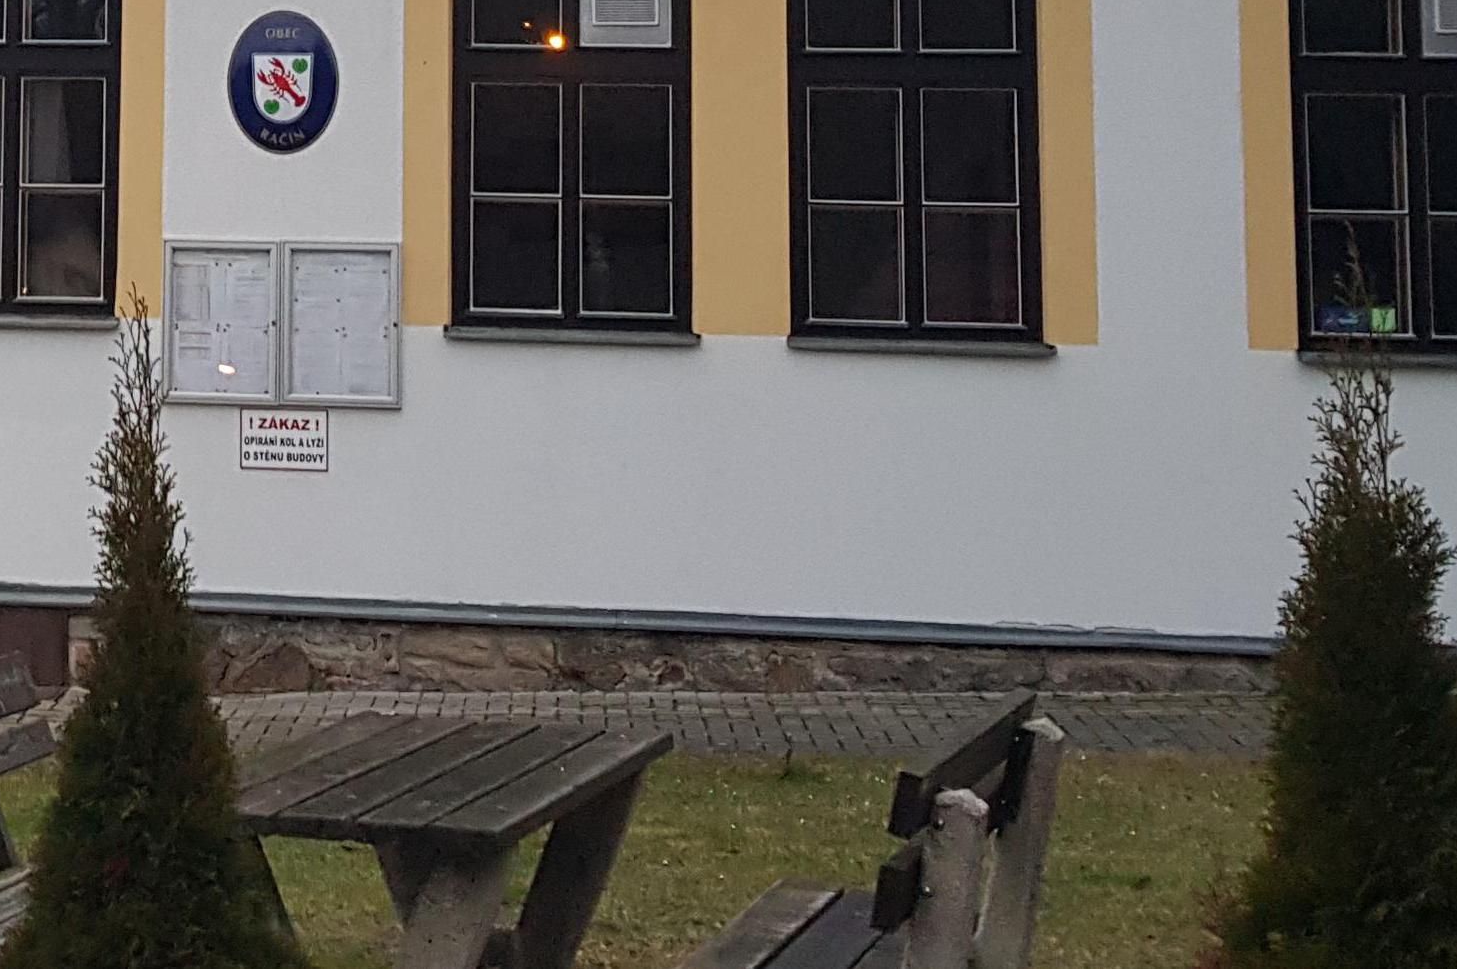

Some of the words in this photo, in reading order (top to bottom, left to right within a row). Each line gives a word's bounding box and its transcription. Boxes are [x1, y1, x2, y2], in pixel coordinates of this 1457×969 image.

[280, 437, 297, 447] KOL
[299, 438, 304, 447] A
[244, 451, 250, 461] O
[286, 452, 325, 464] BUDOVY
